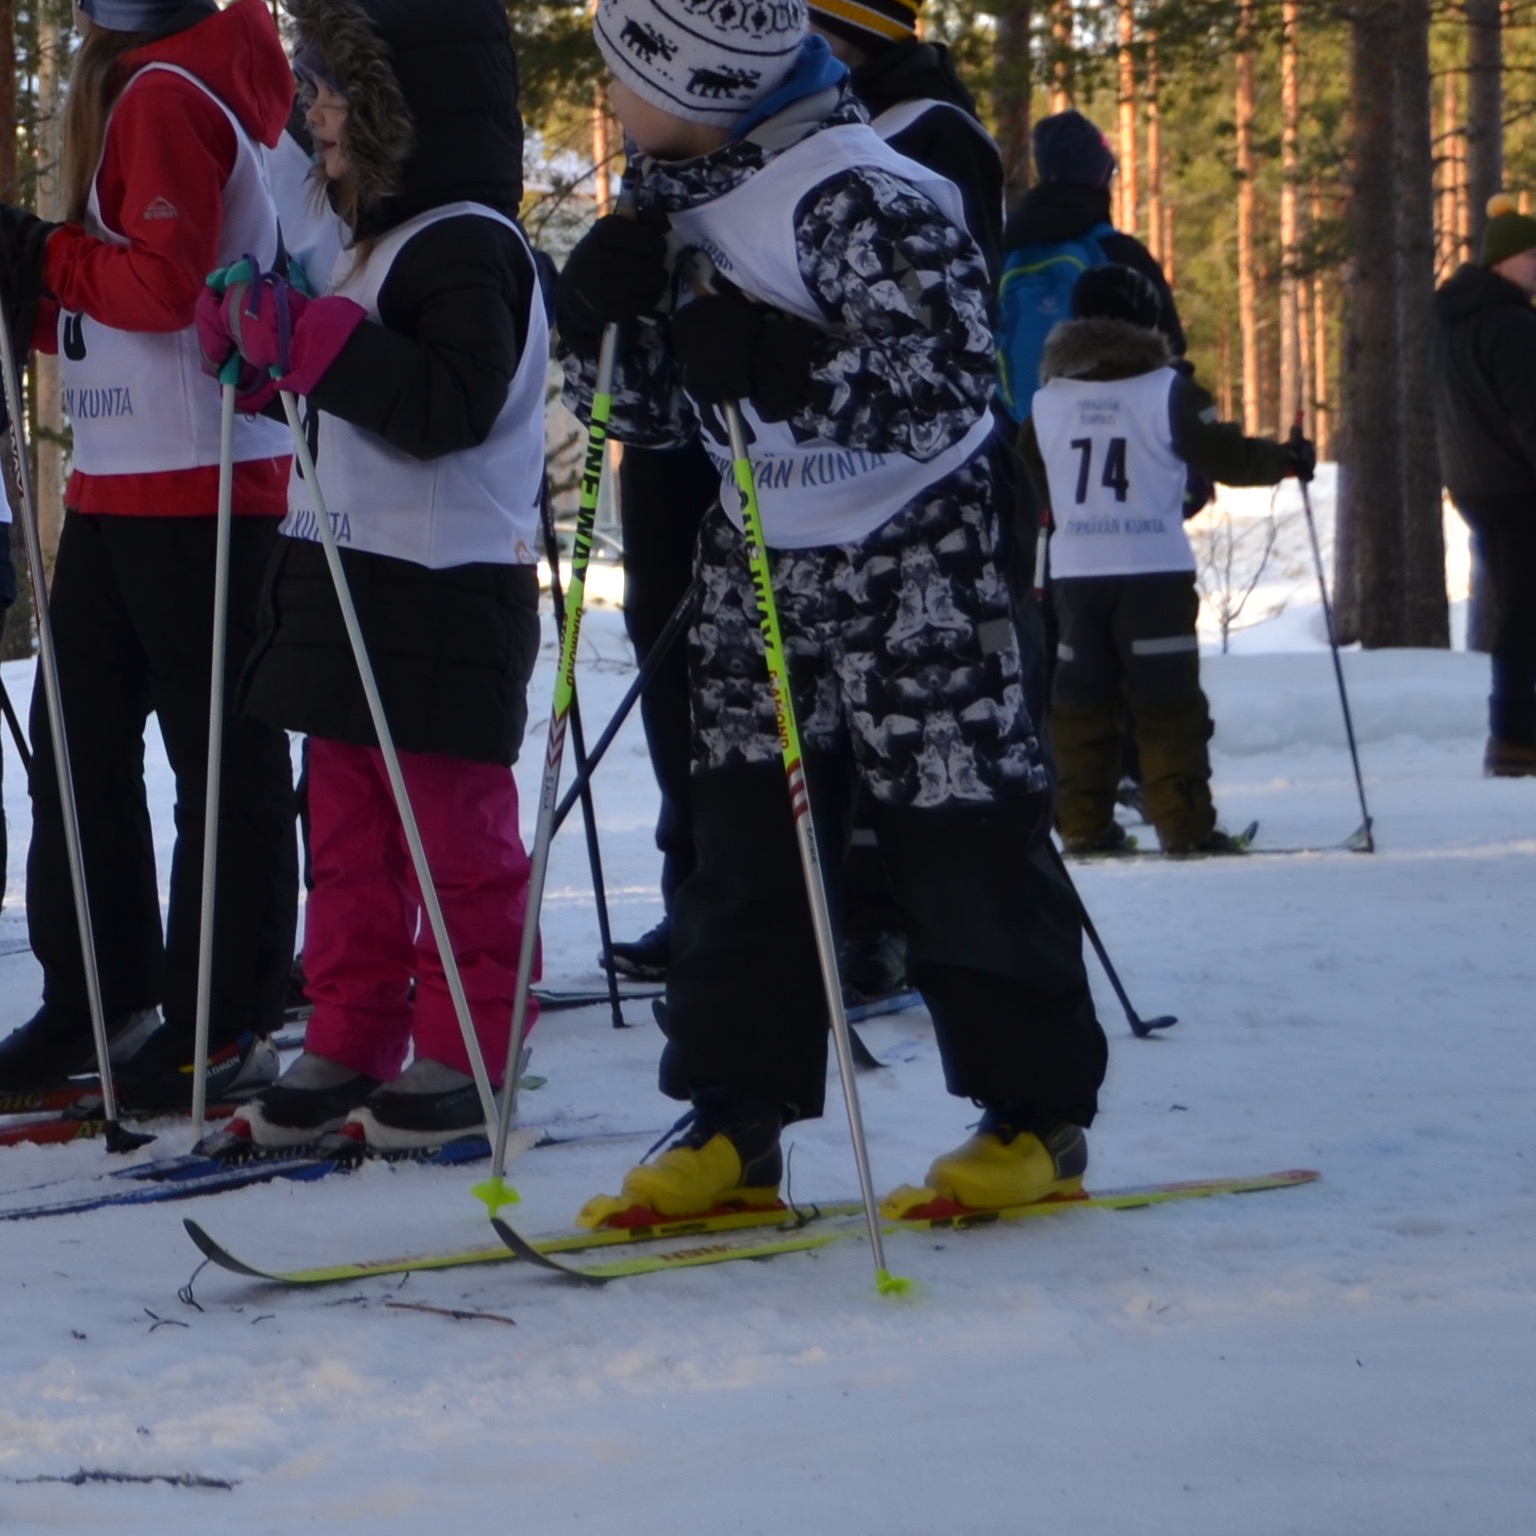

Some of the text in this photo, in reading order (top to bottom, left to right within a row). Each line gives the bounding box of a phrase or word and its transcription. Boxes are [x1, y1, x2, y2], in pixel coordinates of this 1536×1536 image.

[78, 387, 133, 418] KUNTA
[801, 448, 887, 488] KUNTA
[1071, 437, 1129, 504] 74
